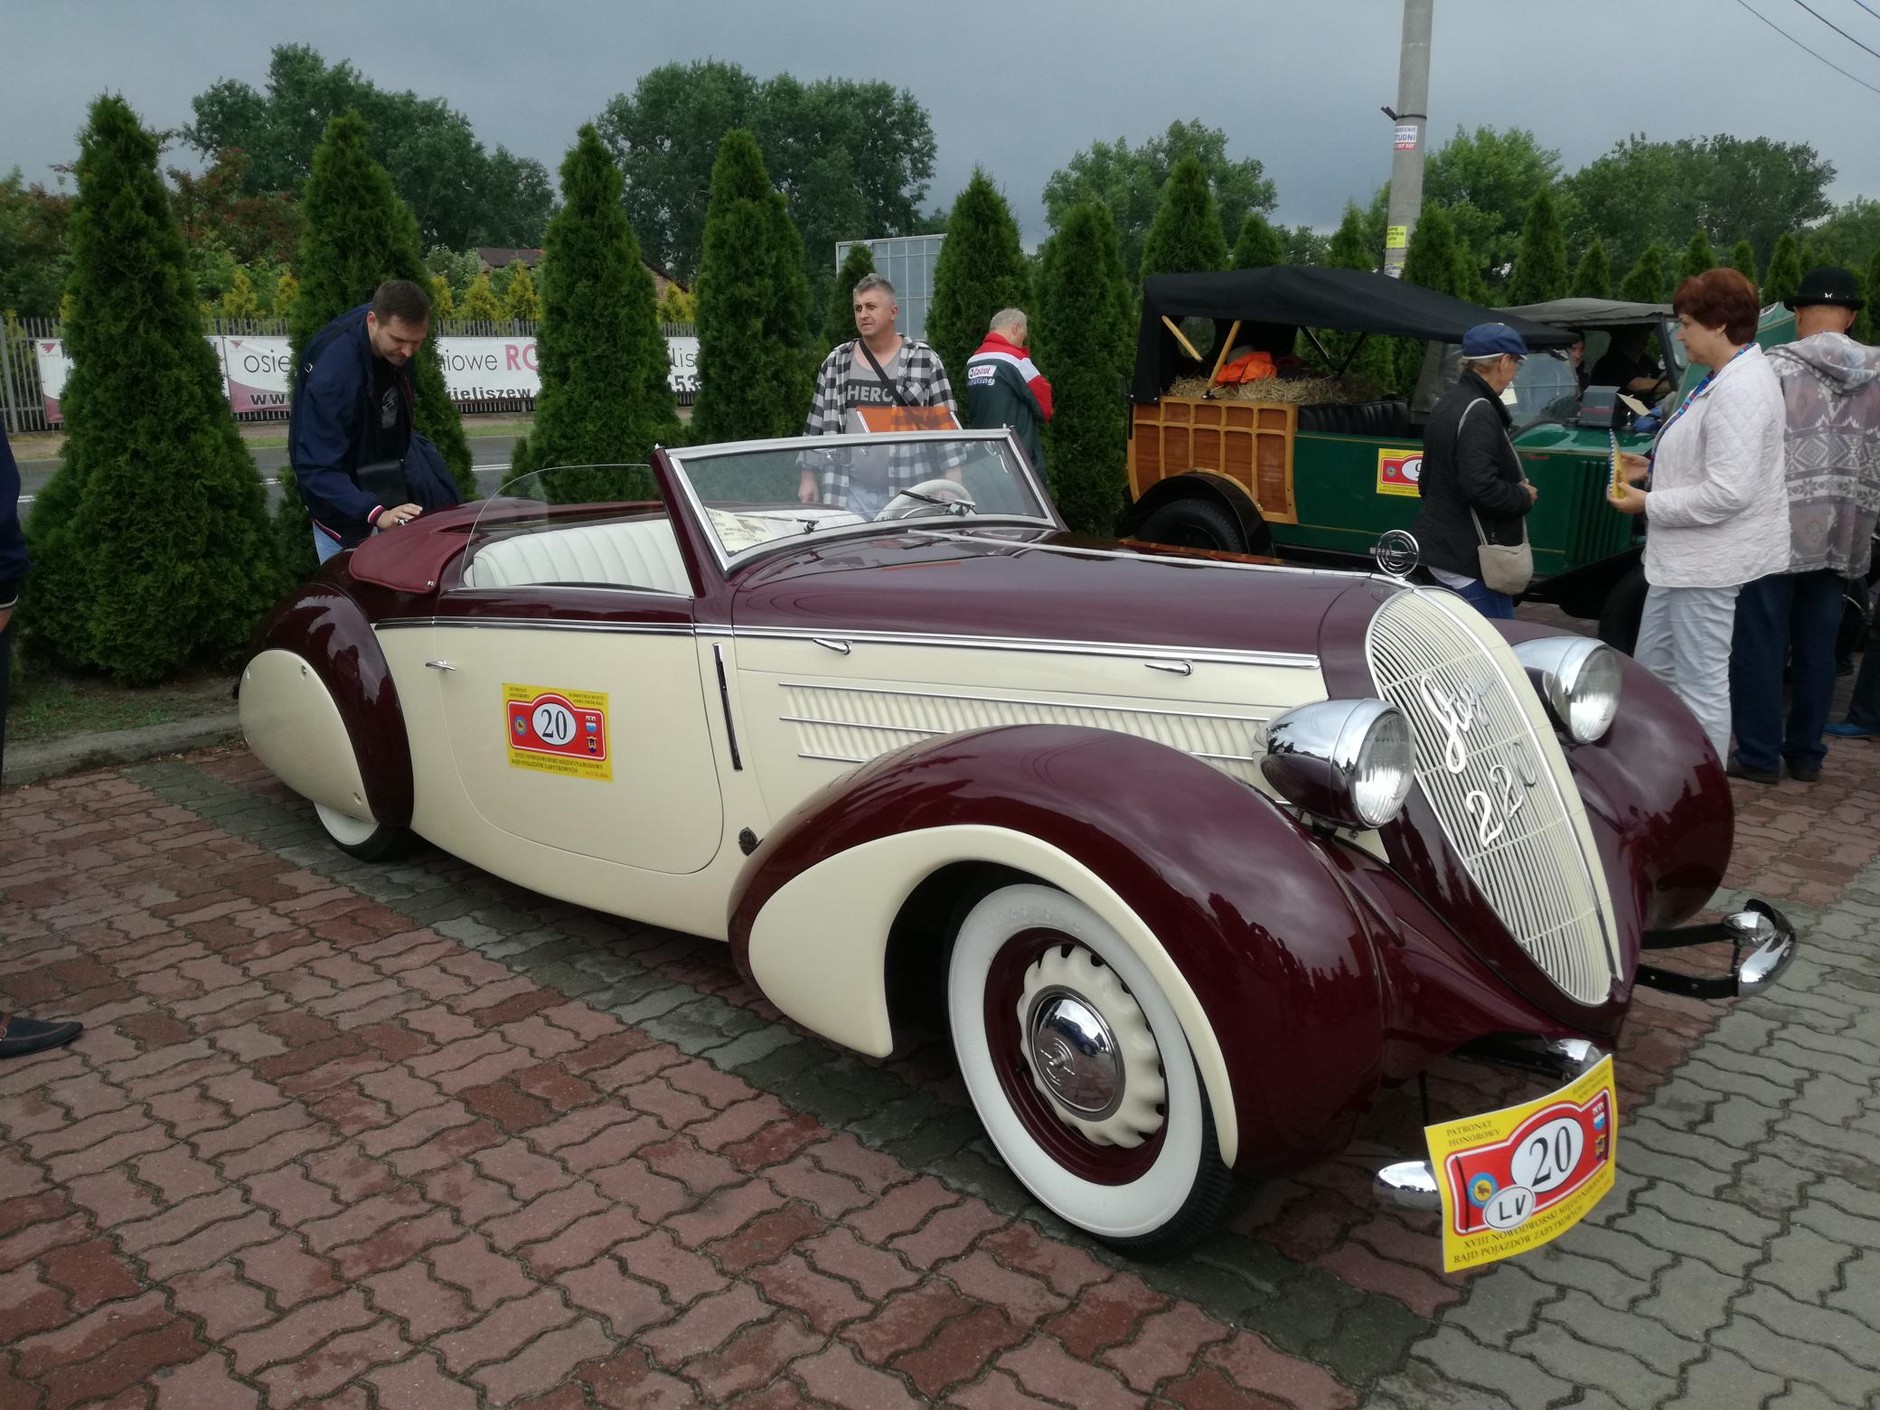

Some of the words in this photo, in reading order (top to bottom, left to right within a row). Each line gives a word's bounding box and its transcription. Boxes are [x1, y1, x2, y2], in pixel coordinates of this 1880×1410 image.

[541, 709, 567, 740] 20
[1466, 741, 1536, 847] 220
[1529, 1126, 1572, 1187] 20
[1499, 1195, 1526, 1221] LV
[1453, 1250, 1478, 1264] RAJD
